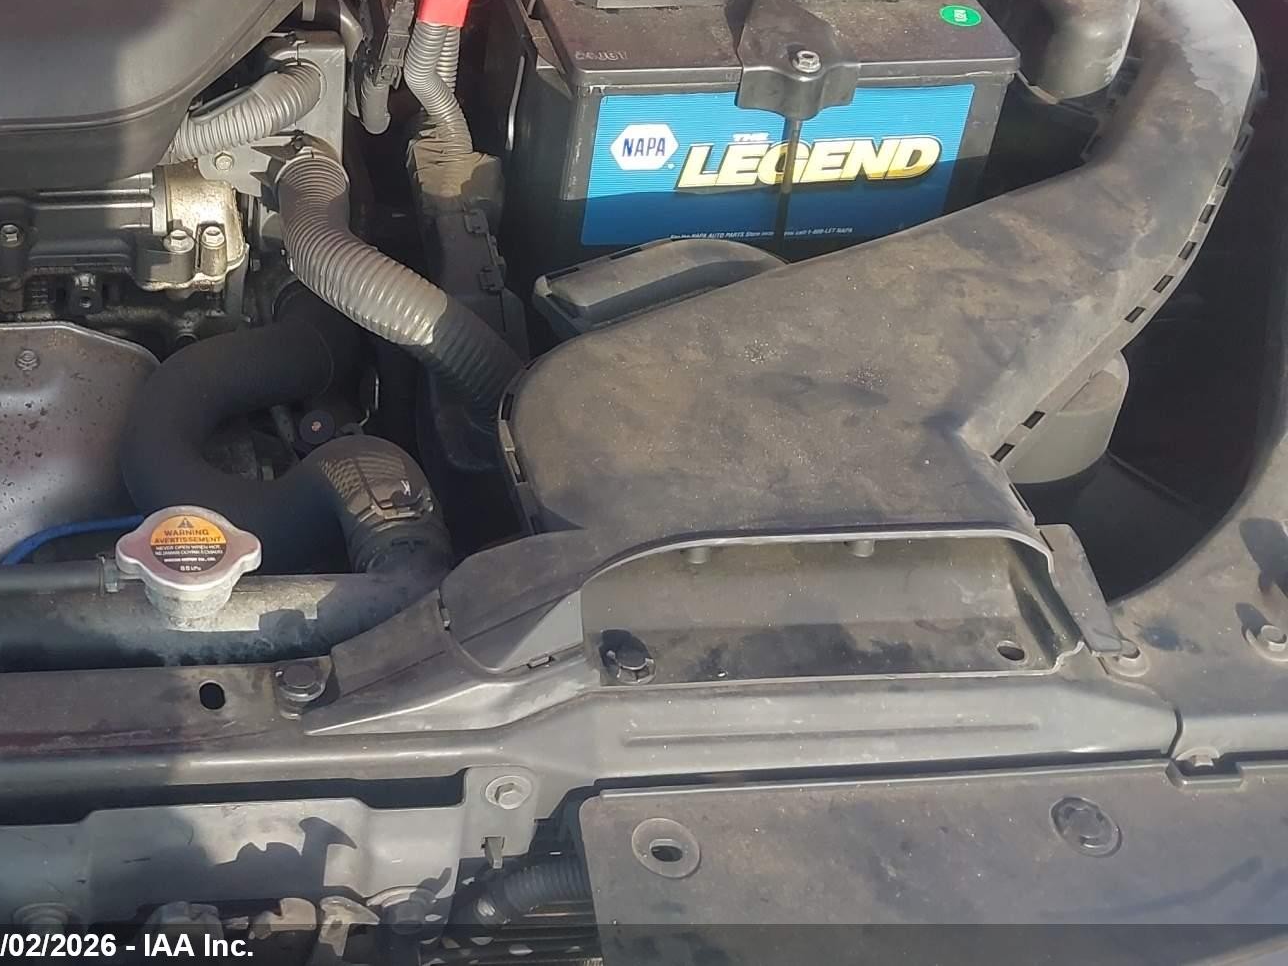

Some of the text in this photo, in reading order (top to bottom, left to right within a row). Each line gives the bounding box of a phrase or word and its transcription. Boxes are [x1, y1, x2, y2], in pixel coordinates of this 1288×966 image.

[621, 135, 668, 159] NAPA
[675, 134, 943, 191] LEGEND
[154, 536, 222, 544] AVERTISSEMENT
